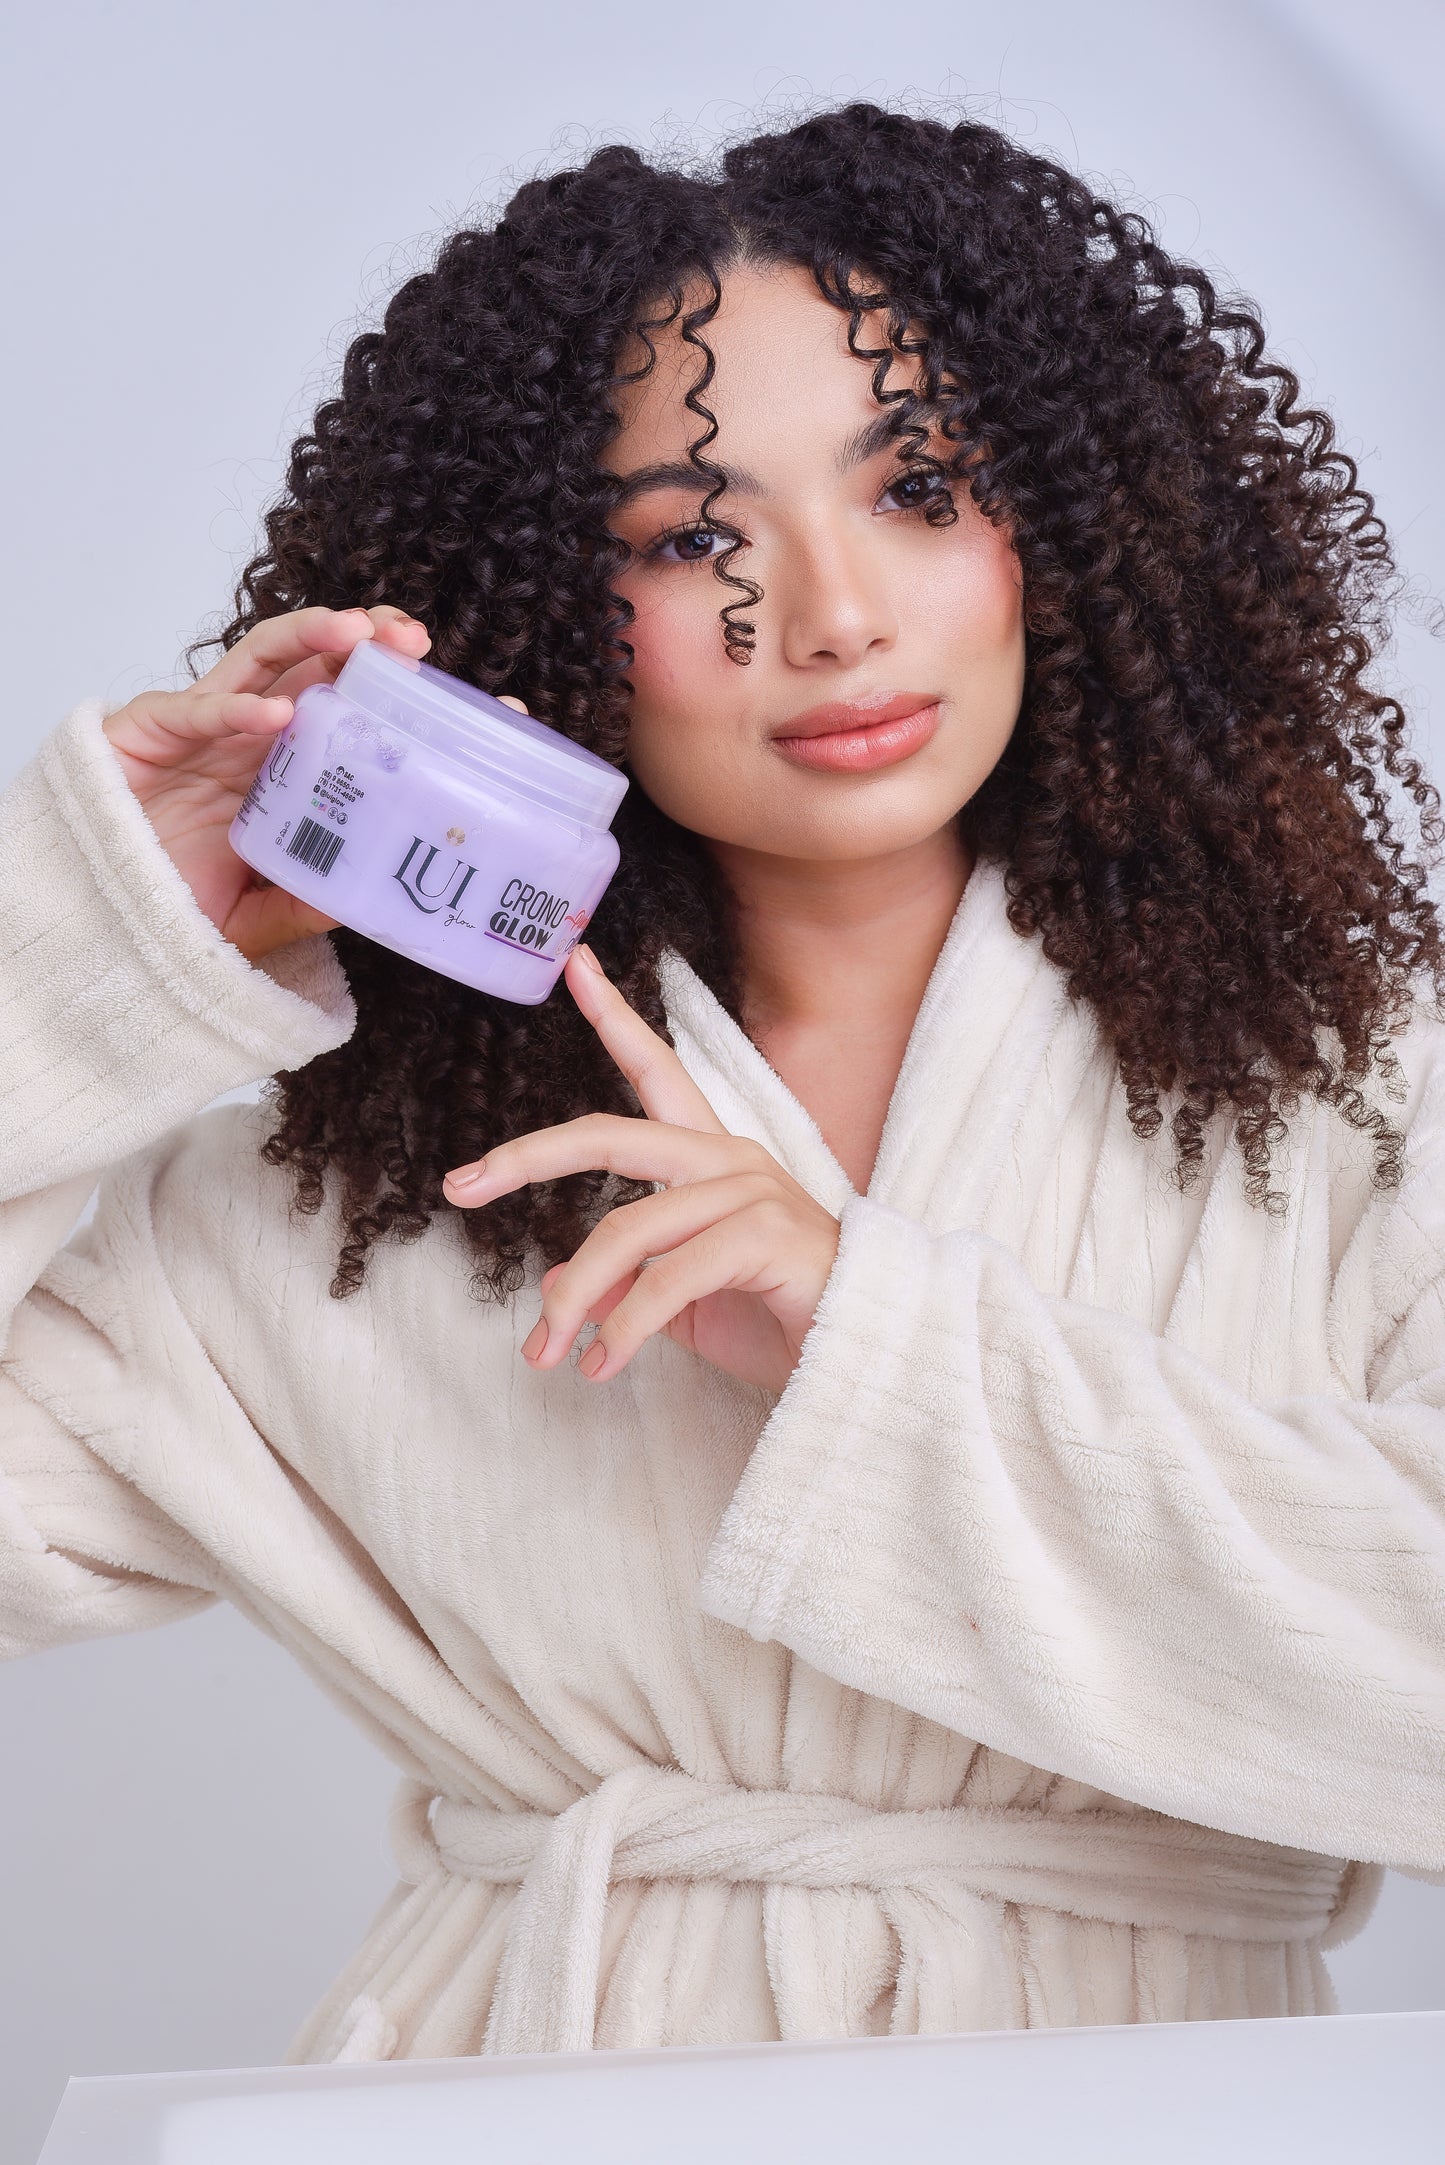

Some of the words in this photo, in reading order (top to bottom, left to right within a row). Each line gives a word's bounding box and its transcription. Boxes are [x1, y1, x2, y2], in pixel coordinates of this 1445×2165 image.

[344, 771, 354, 781] SAC
[391, 835, 479, 914] LUI
[444, 909, 476, 928] glow
[500, 878, 570, 929] CRONO
[489, 911, 554, 951] GLOW
